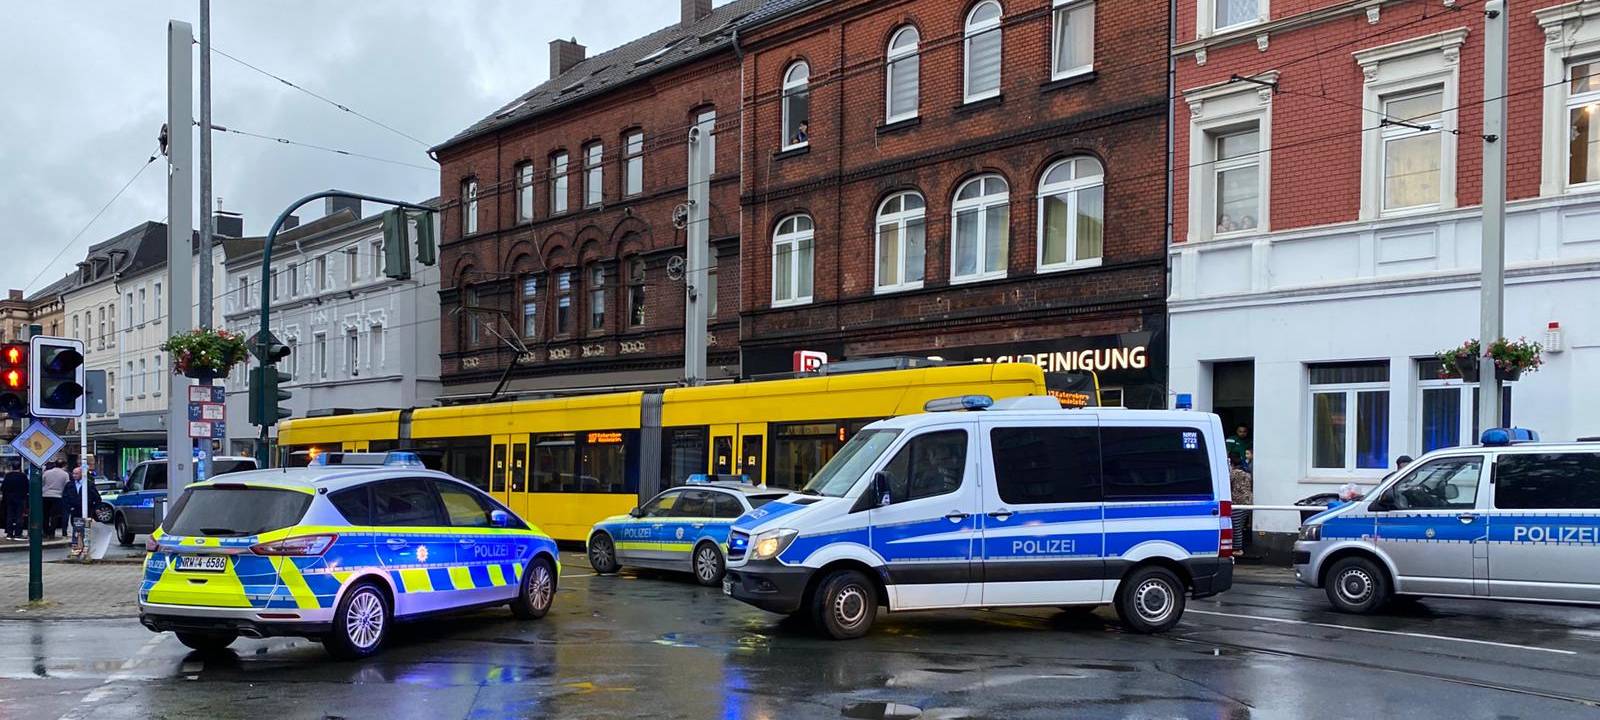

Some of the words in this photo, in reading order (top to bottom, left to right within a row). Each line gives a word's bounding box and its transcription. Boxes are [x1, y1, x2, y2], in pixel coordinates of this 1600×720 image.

[973, 346, 1146, 373] EINIGUNG
[624, 527, 651, 538] POLIZEI
[1513, 526, 1599, 542] POLIZEI
[474, 545, 509, 557] POLIZEI
[1012, 539, 1076, 554] POLIZEI
